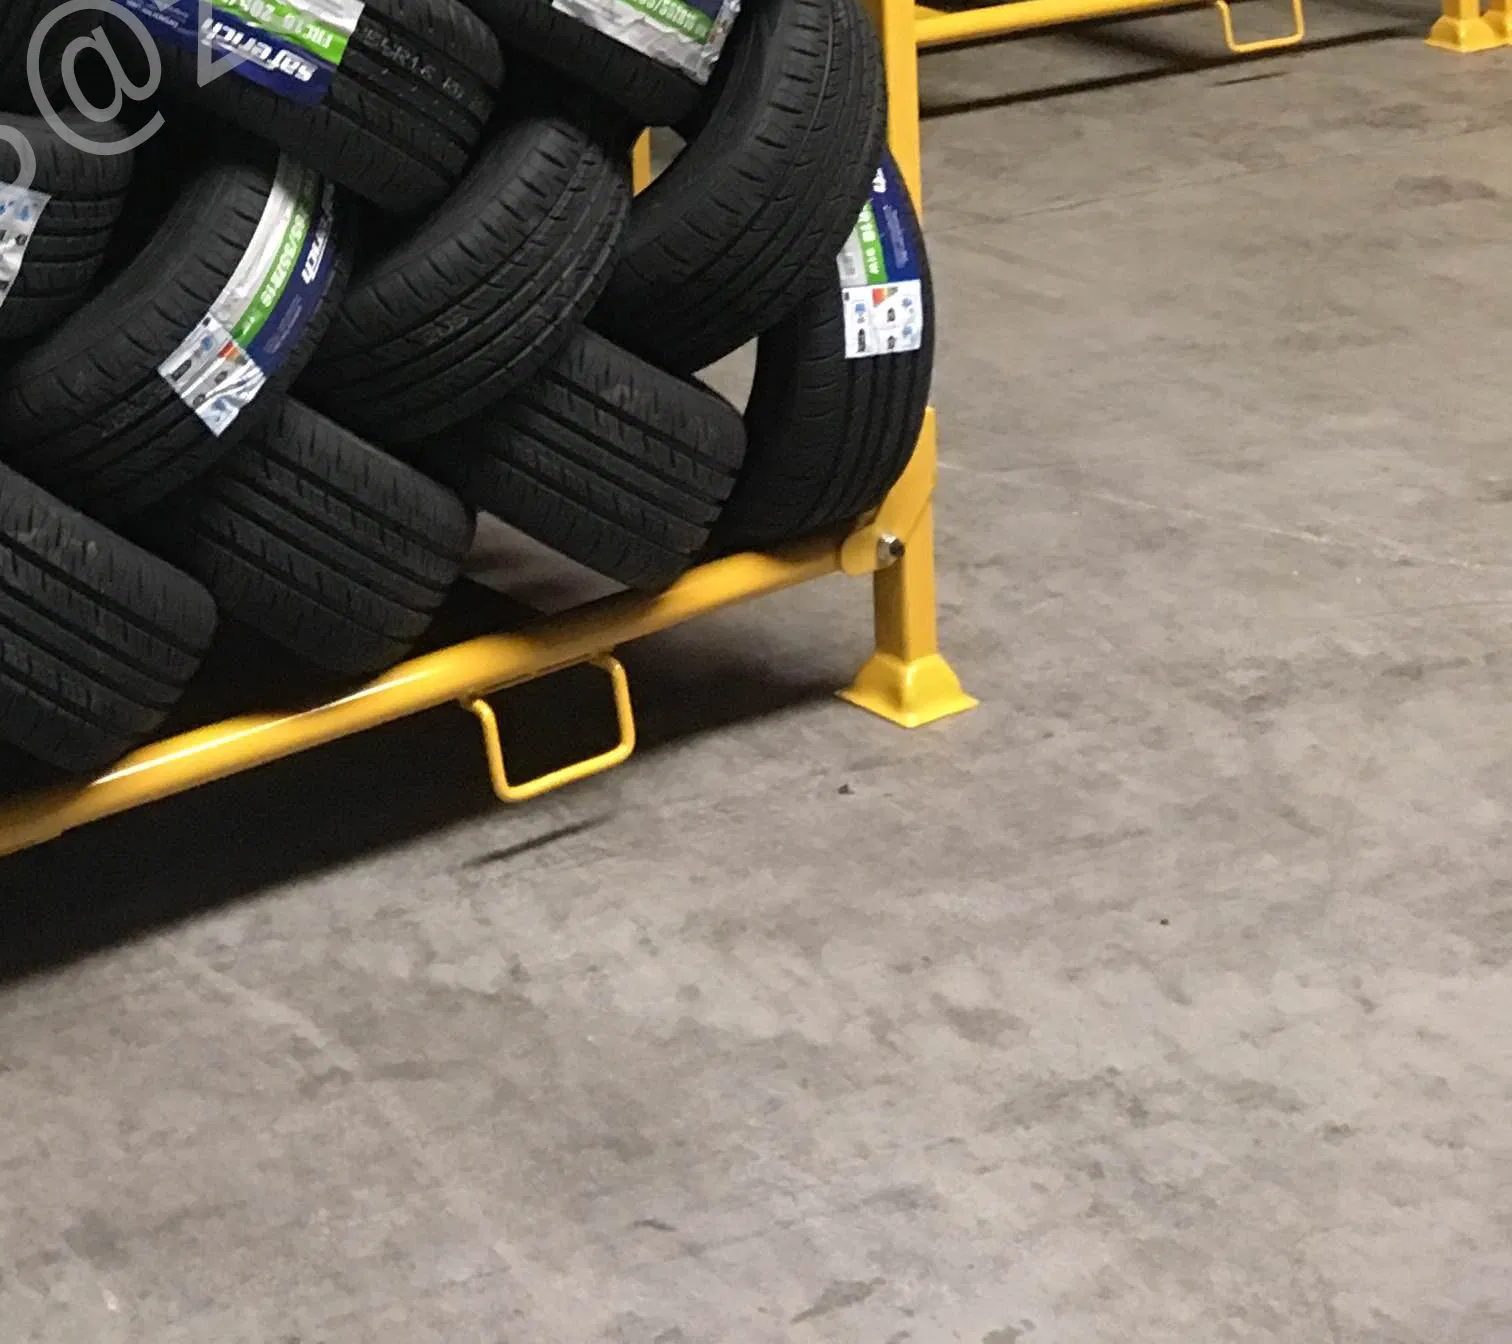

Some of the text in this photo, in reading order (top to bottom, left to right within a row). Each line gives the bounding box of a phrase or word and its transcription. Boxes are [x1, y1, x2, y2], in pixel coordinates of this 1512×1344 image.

[279, 12, 334, 48] FRC16
[196, 15, 317, 85] saferich
[865, 247, 880, 275] 91W
